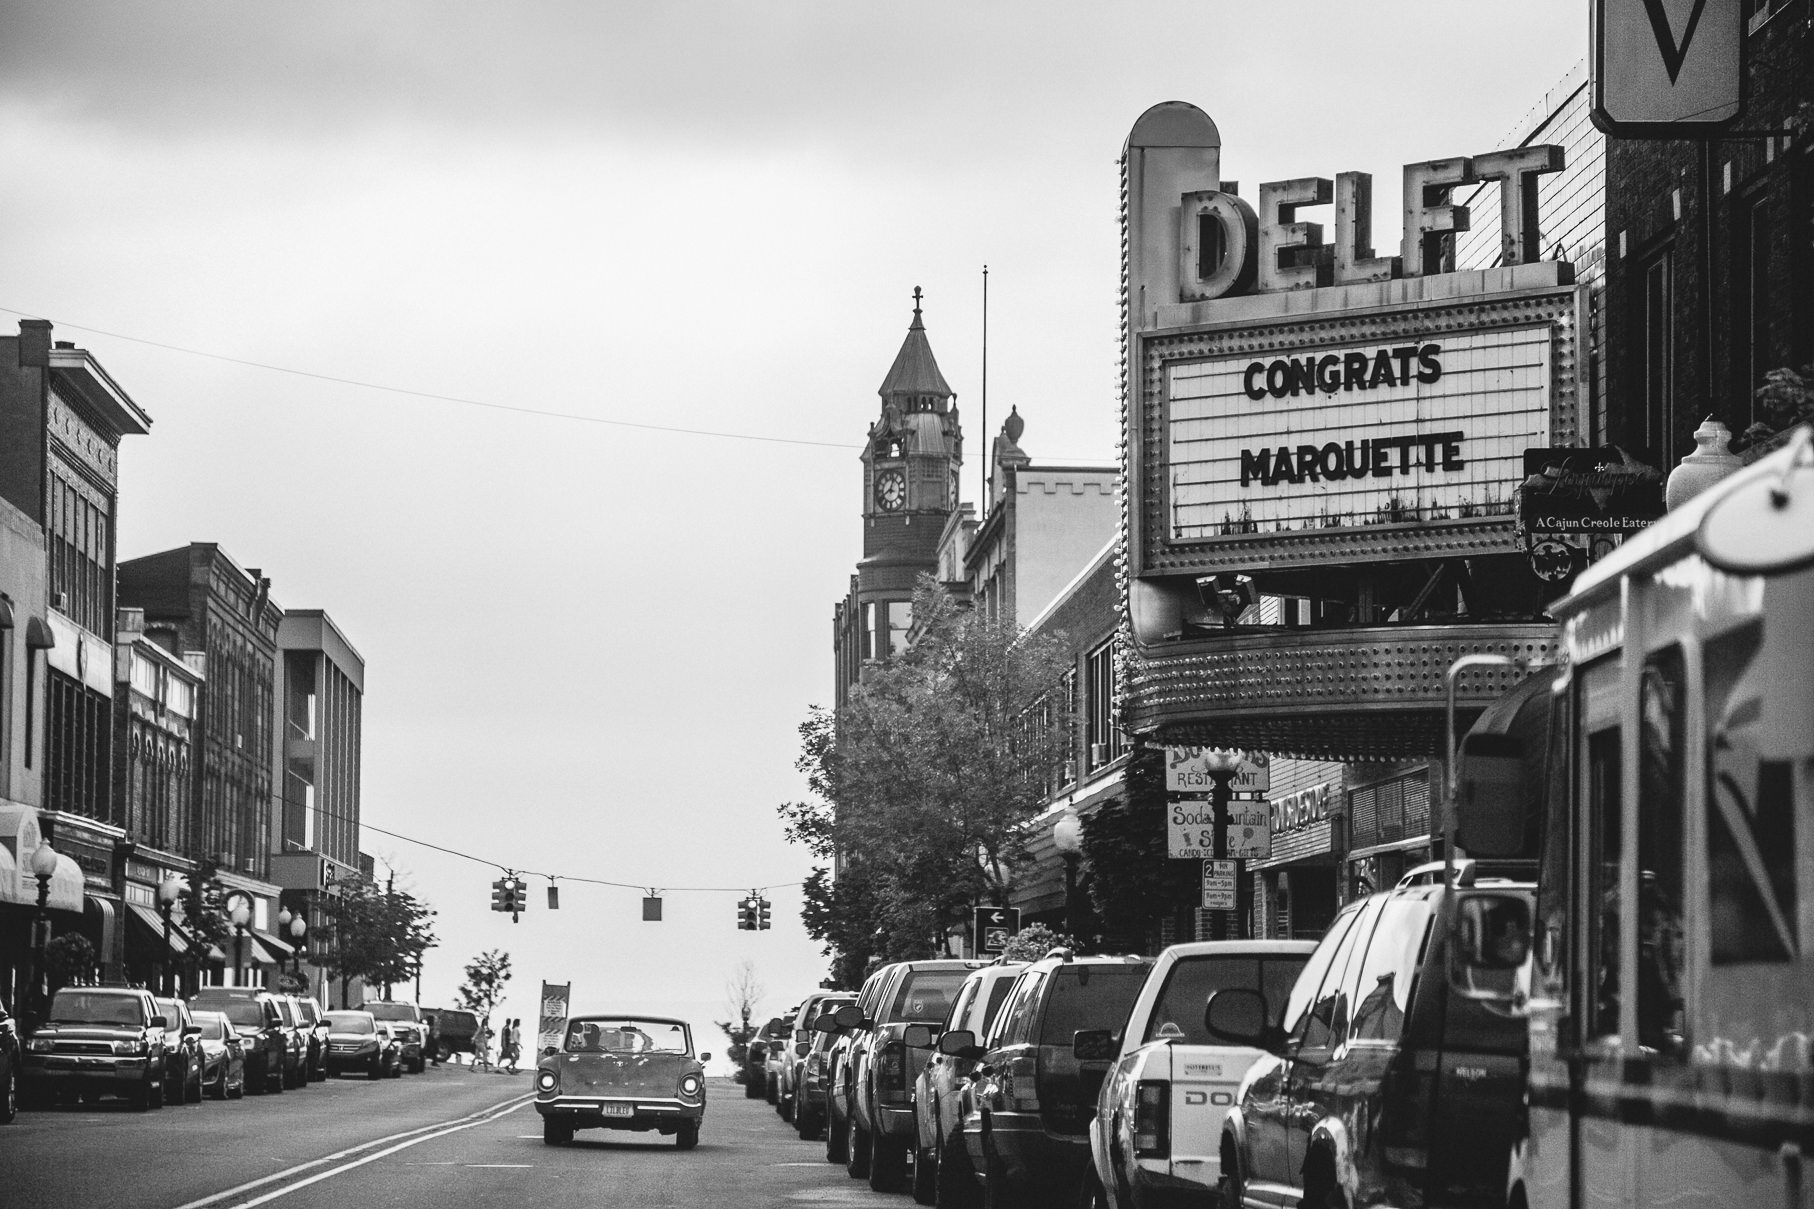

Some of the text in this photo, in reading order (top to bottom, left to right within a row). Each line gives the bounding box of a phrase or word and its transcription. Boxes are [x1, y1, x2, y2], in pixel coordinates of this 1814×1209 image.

[1179, 144, 1565, 303] DELFT
[1243, 343, 1442, 400] CONGRATS
[1240, 430, 1465, 488] MARQUETTE
[1536, 517, 1545, 528] A
[1546, 516, 1579, 531] Cajun
[1581, 516, 1620, 528] Creole
[1177, 772, 1258, 788] RESTANT
[1205, 864, 1213, 877] 2
